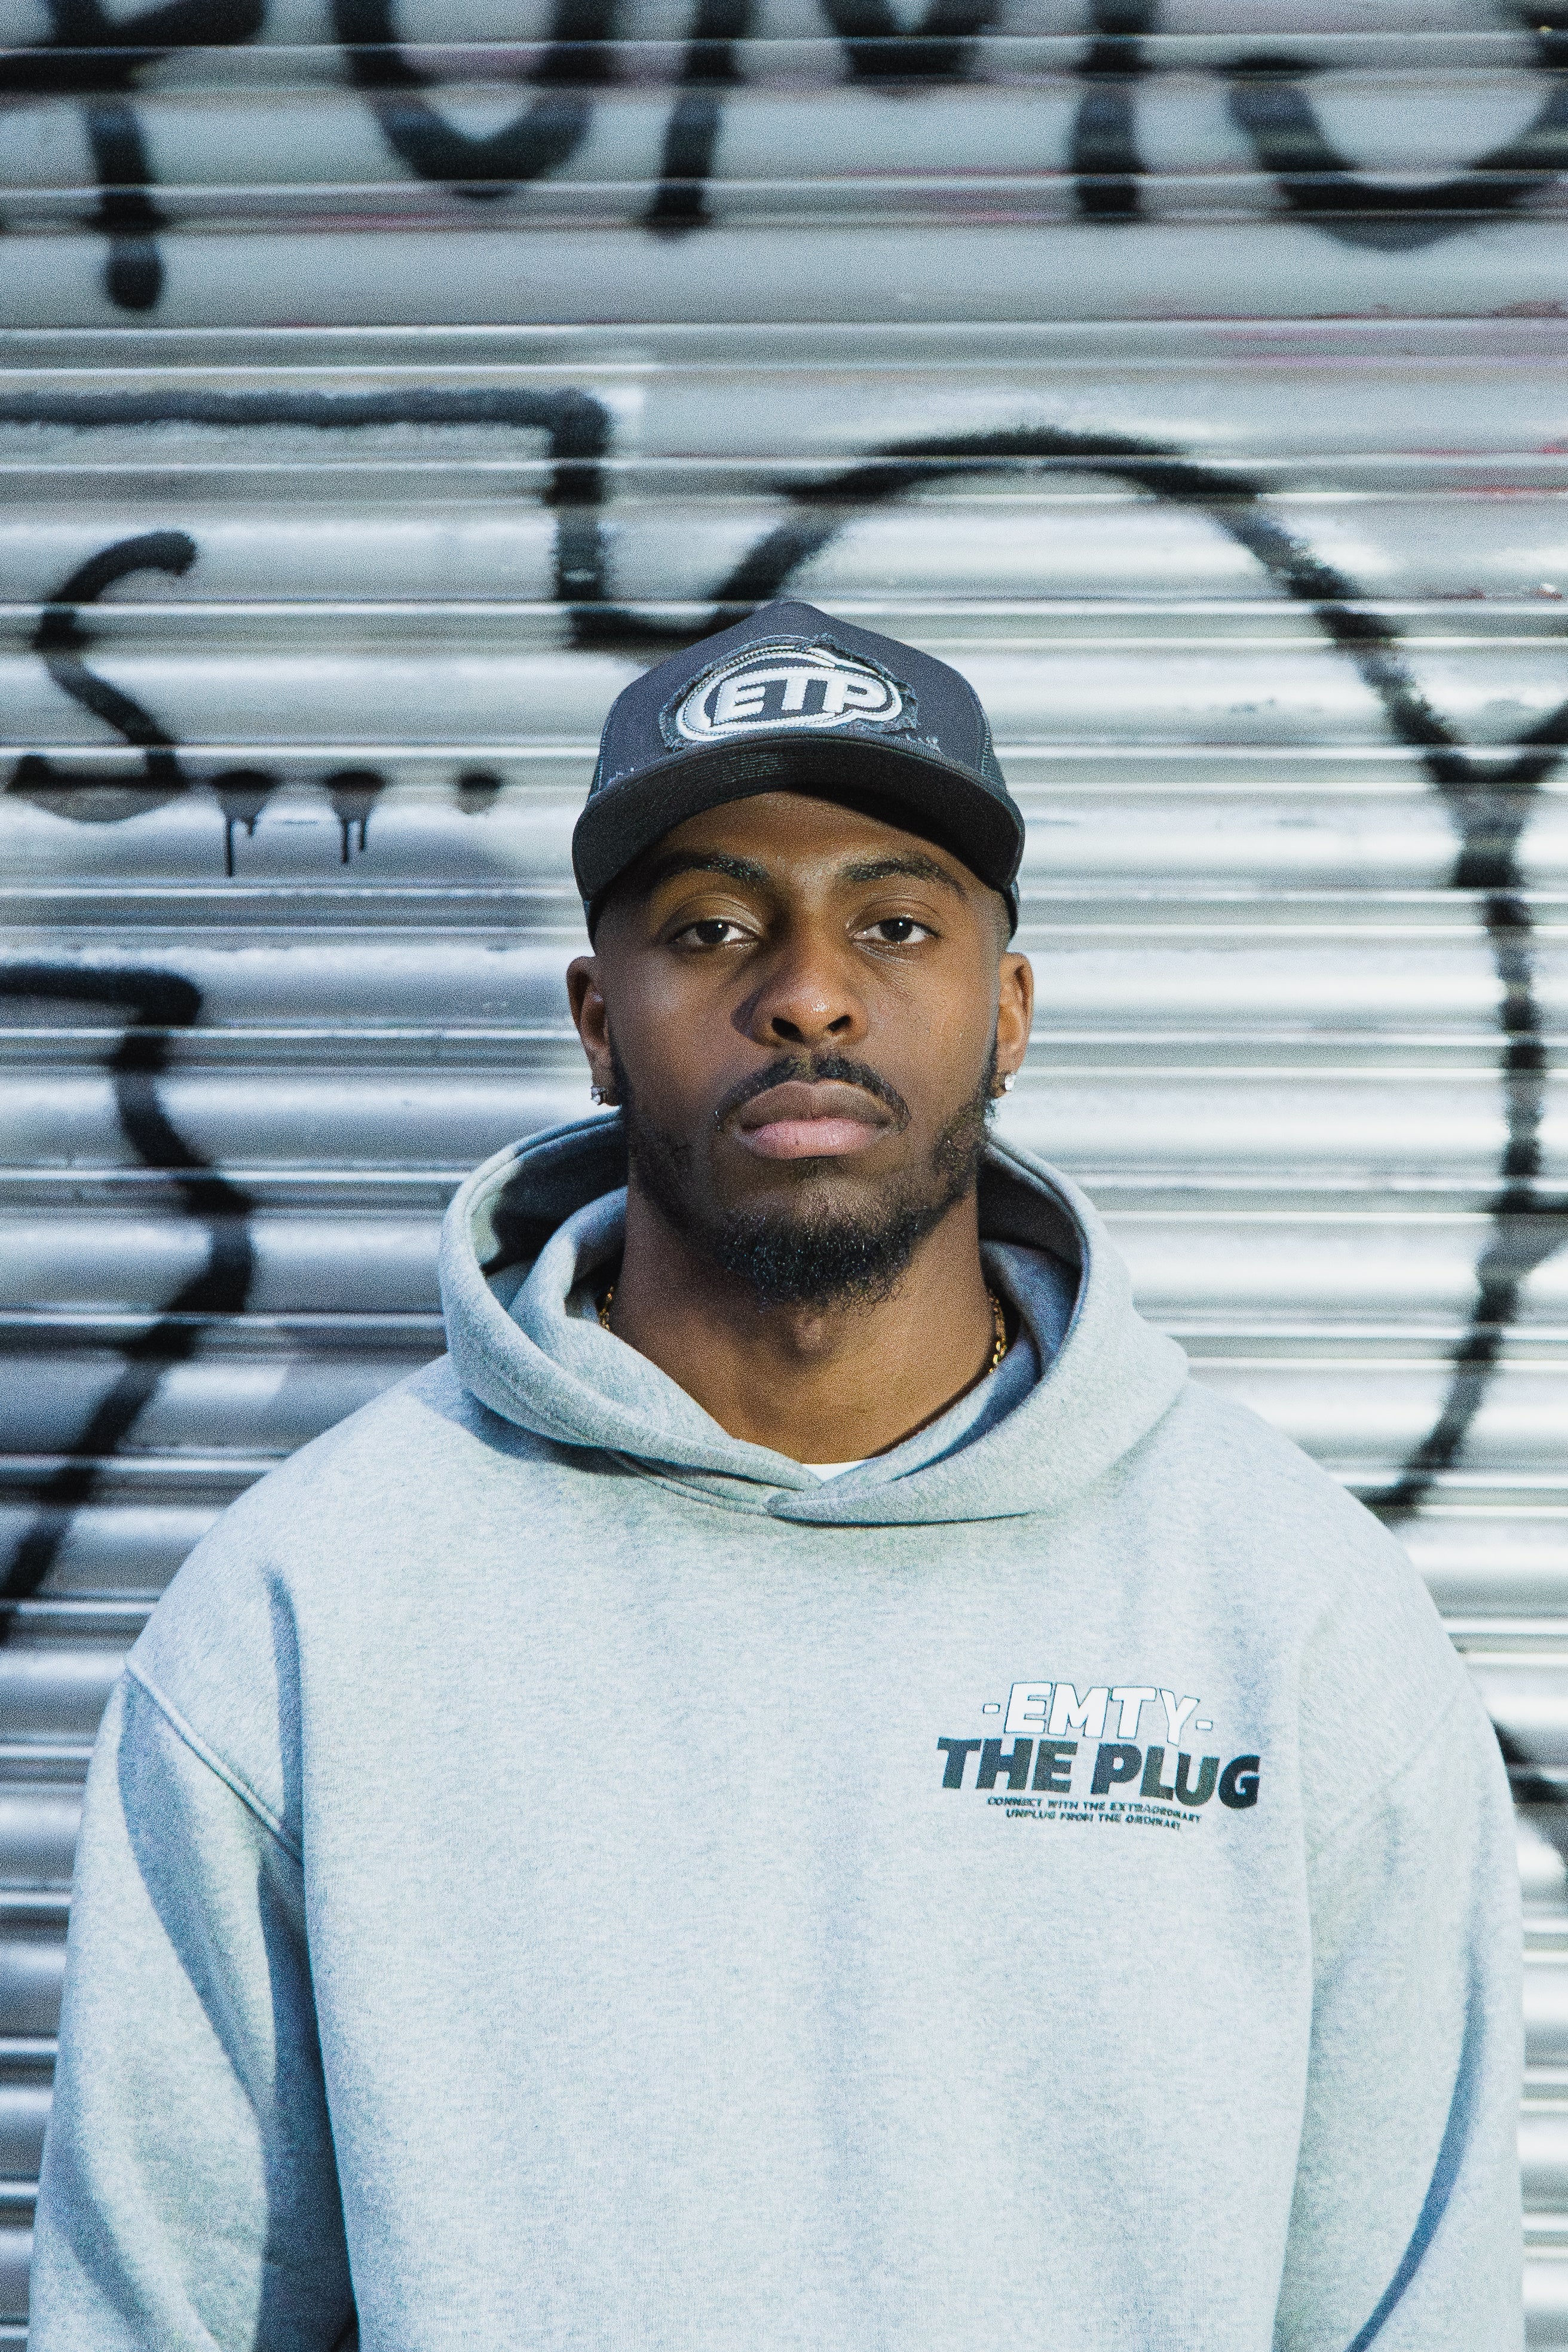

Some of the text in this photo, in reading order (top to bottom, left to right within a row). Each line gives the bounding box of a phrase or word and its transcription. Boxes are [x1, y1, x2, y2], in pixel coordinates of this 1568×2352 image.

[711, 666, 889, 727] ETP
[937, 1737, 1261, 1809] THE PLUG
[987, 1796, 1042, 1807] CONNECT
[1048, 1799, 1078, 1810] WITH
[1083, 1800, 1105, 1811] THE
[1005, 1808, 1056, 1820] UNPLUG
[1059, 1811, 1094, 1822] FROM
[1098, 1812, 1122, 1823] THE
